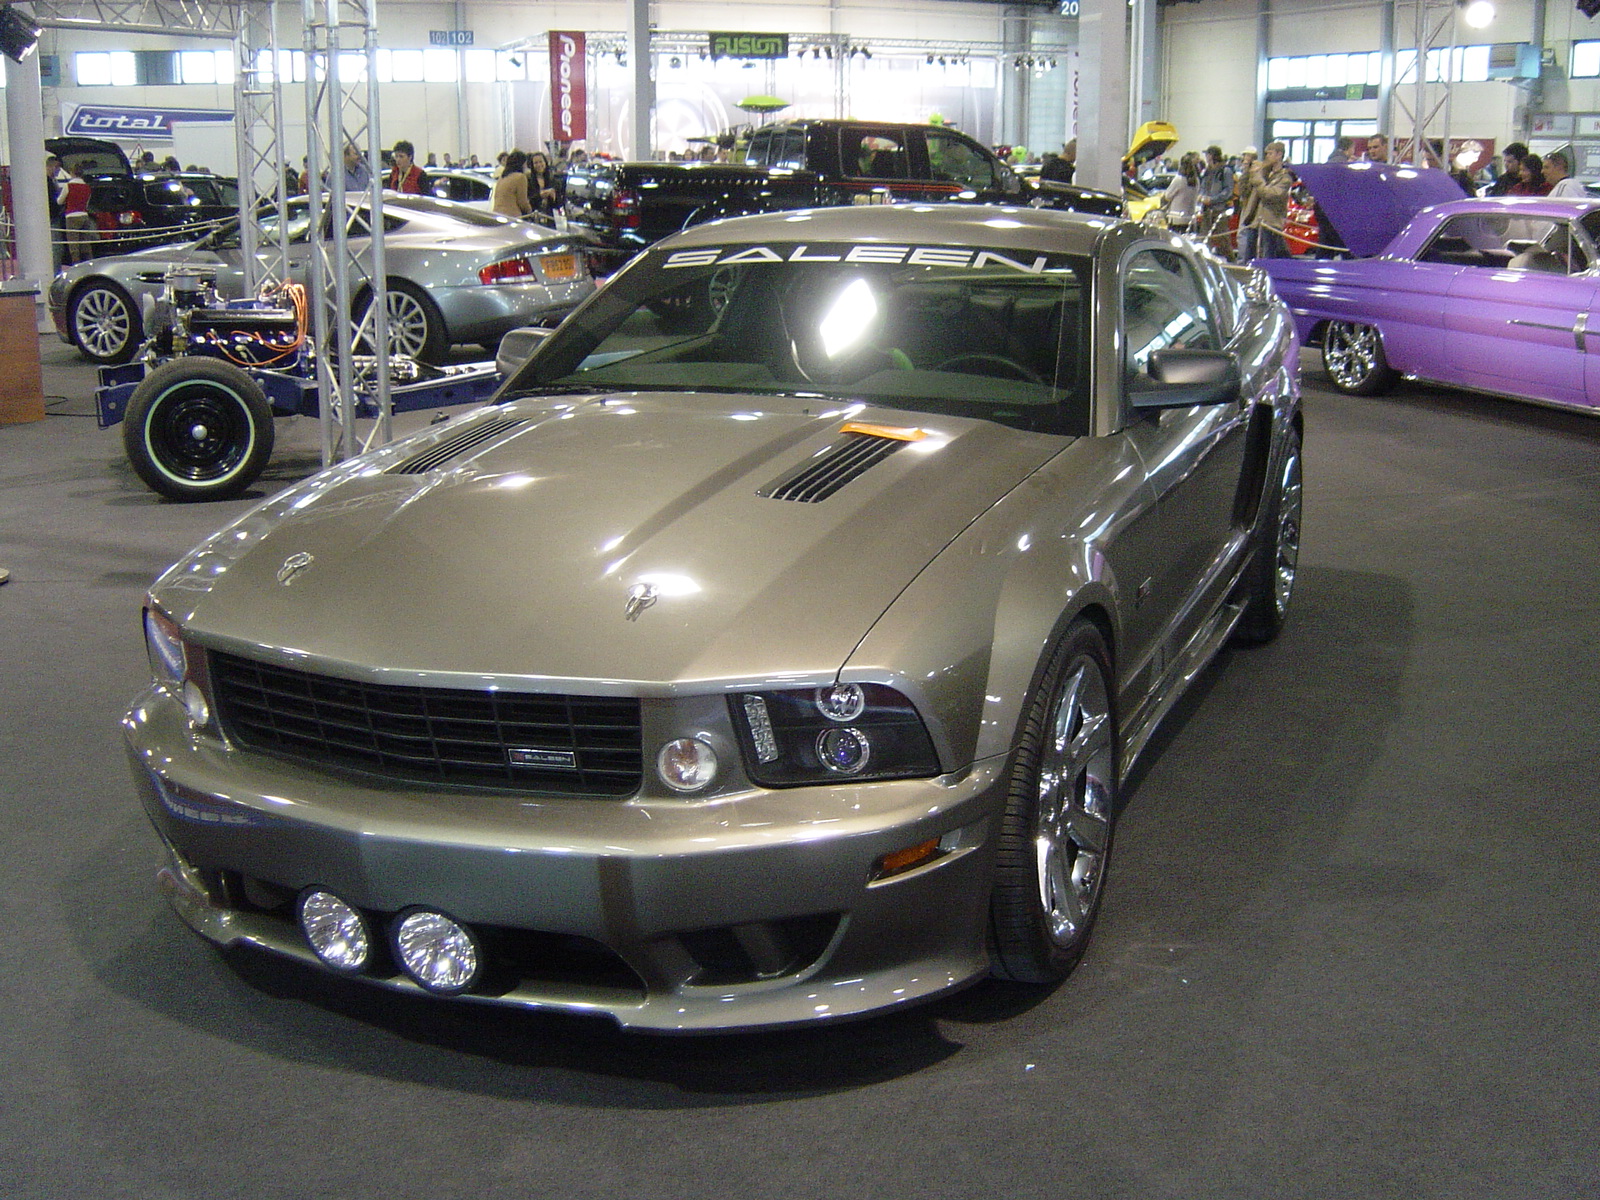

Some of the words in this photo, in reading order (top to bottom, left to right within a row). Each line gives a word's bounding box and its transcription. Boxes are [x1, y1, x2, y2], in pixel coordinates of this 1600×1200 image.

[452, 33, 471, 44] 102
[559, 34, 576, 138] Pioneer
[79, 114, 167, 130] total
[662, 245, 1046, 274] SALEEN
[524, 753, 571, 762] SALEEN
